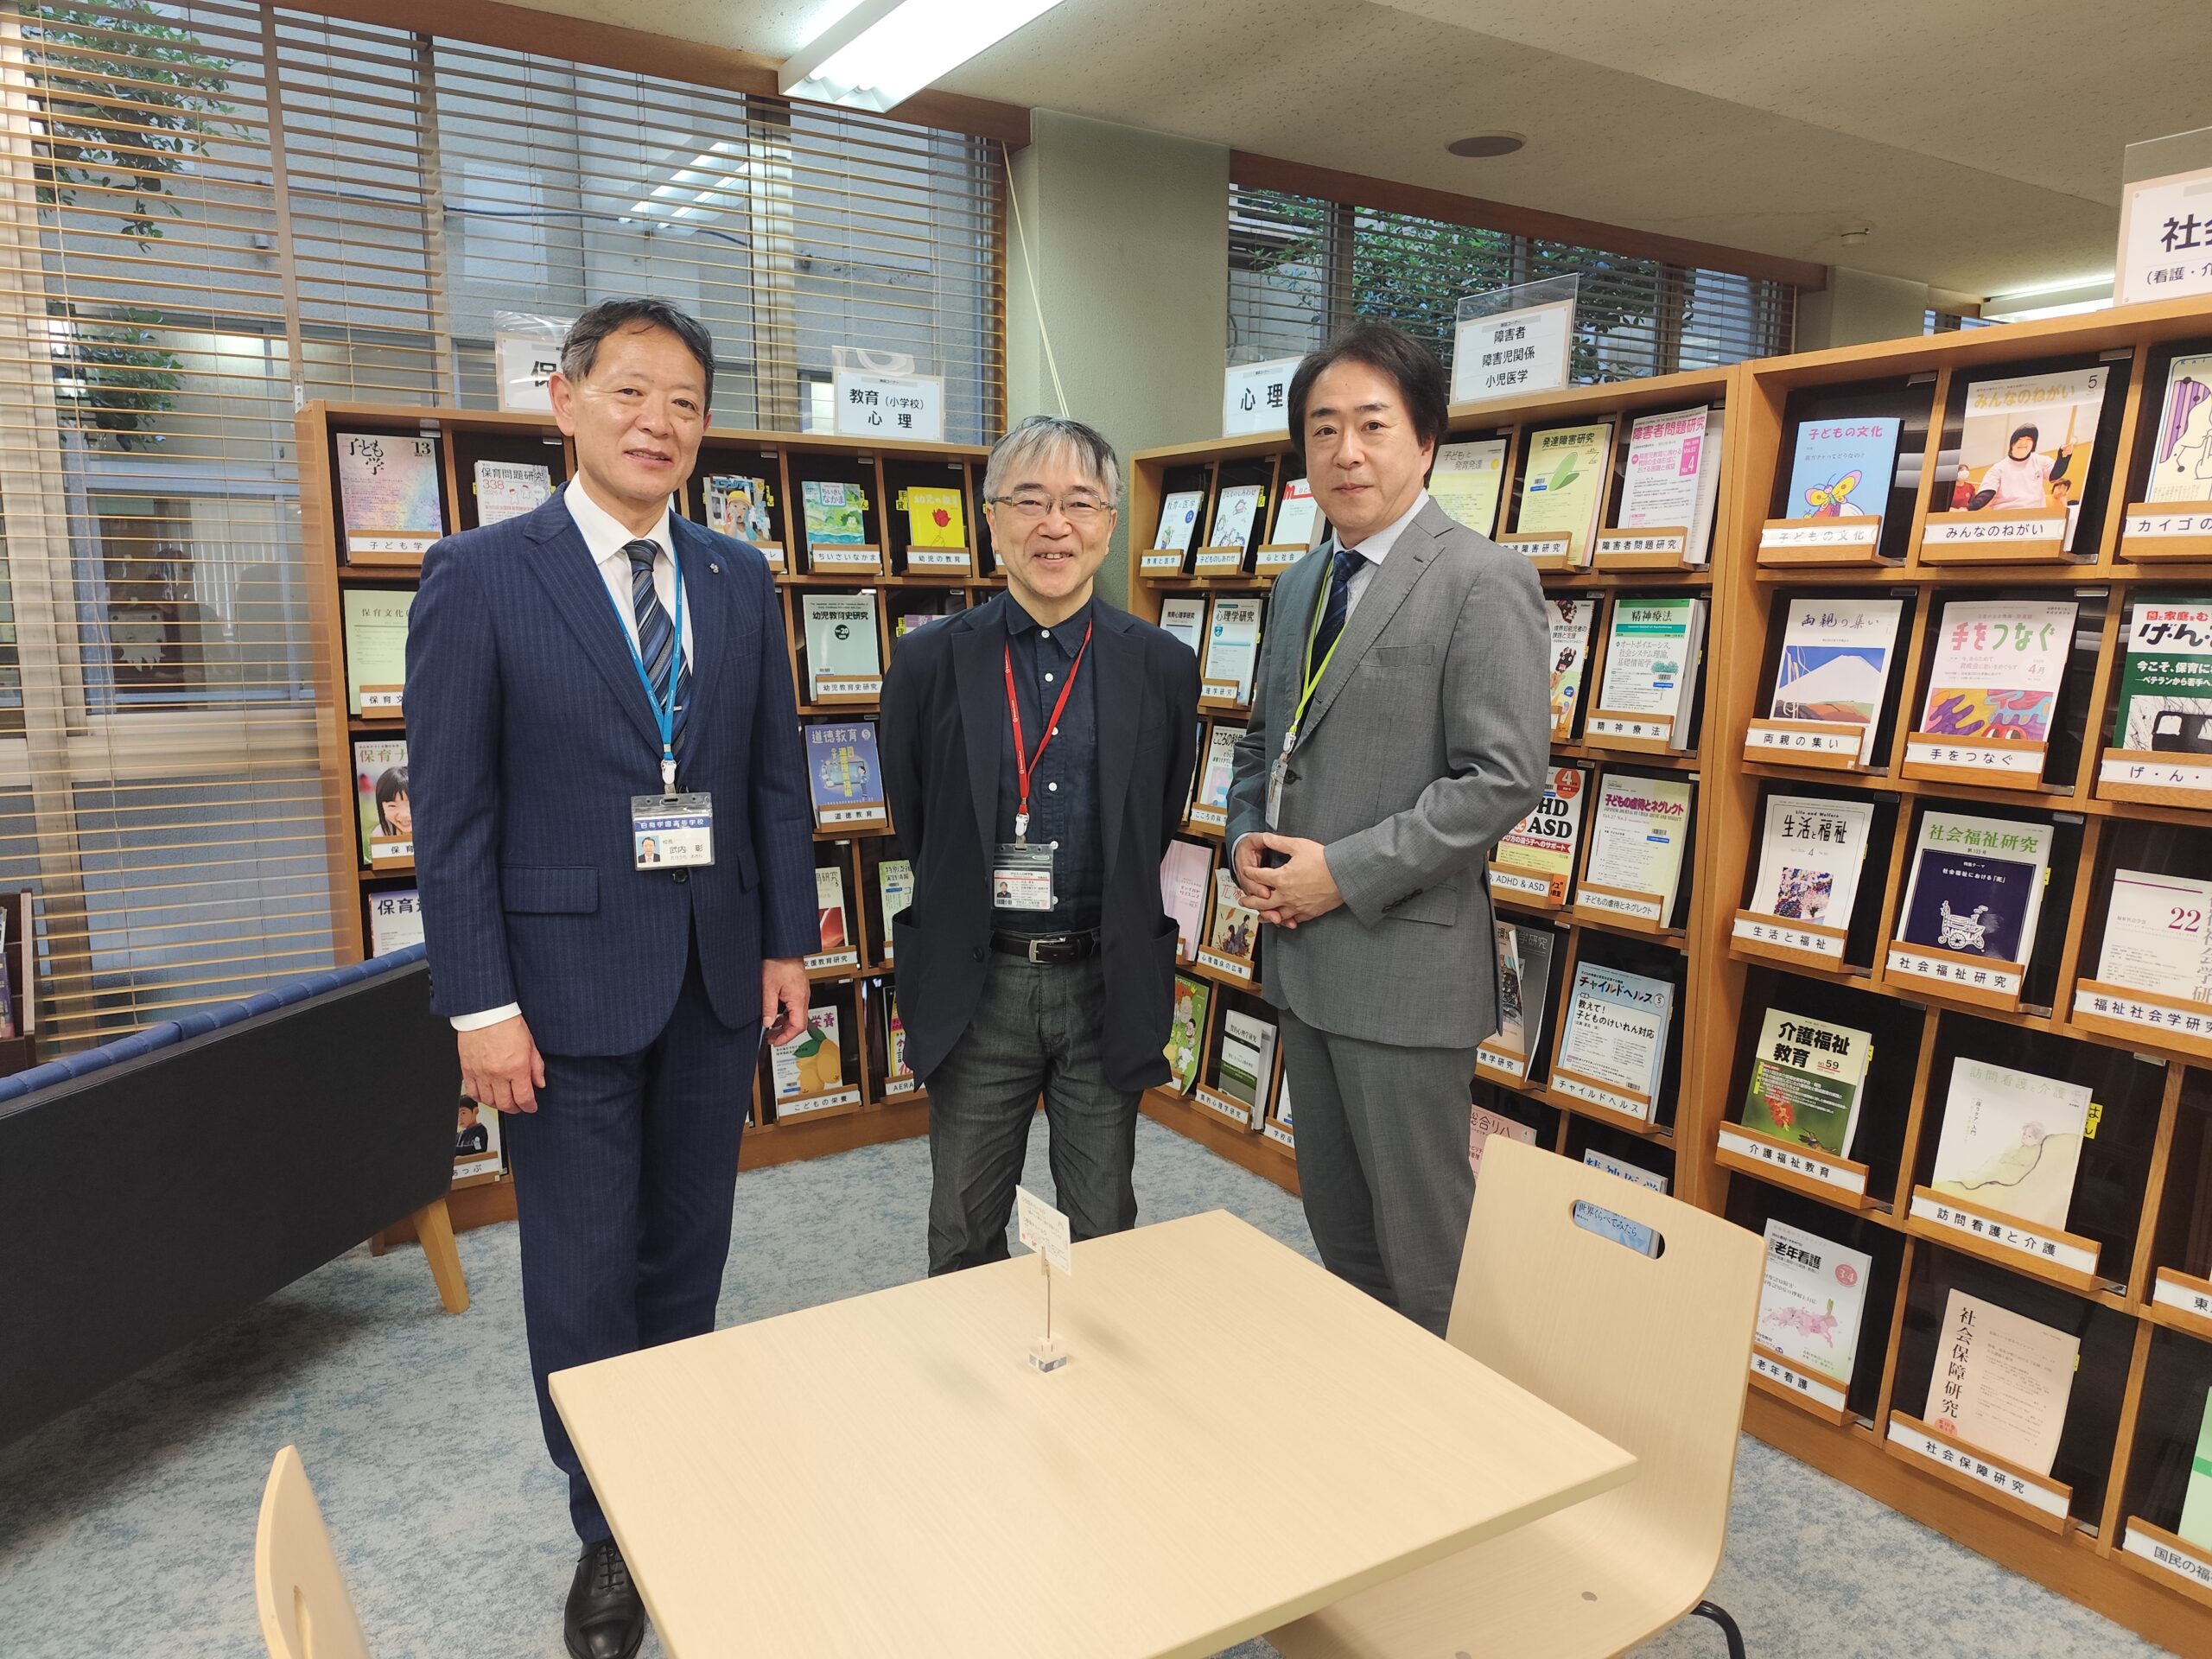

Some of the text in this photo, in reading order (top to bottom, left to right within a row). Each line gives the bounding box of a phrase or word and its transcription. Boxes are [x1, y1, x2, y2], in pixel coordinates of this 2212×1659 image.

[1493, 326, 1526, 344] 障害者
[1482, 346, 1535, 367] 障害児関係
[1485, 369, 1528, 388] 小児医学
[2088, 375, 2098, 389] 5
[1974, 385, 2075, 409] みんなのねがい
[1632, 416, 1706, 442] 障害者問題研究
[1808, 426, 1883, 441] 子どもの文化
[1542, 433, 1595, 448] 発達障害研究
[1444, 450, 1471, 461] 子どもと
[1688, 455, 1694, 471] 4
[1454, 460, 1483, 471] 発育発達
[481, 467, 544, 482] 保育問題研究
[482, 479, 505, 490] 338
[1946, 524, 2044, 538] みんなのねがい
[2138, 518, 2212, 532] カイゴの
[370, 540, 423, 550] 子ども学
[1602, 540, 1676, 550] 障害者問題研究
[1778, 530, 1865, 543] 子どもの文化
[818, 551, 876, 561] ちいさいなかま
[1267, 553, 1294, 562] 心と社会
[362, 608, 409, 617] 保育文化
[812, 611, 868, 620] 幼児教育史研究
[1216, 610, 1255, 622] 心理学研究
[1631, 610, 1673, 621] 精神療法
[2146, 611, 2212, 621] 園と家庭をむ
[1801, 613, 1879, 630] 両親の集い
[1951, 621, 2056, 652] 手をつなぐ
[2139, 623, 2212, 647] げ・ん・
[2137, 660, 2212, 674] 今こそ、保育に
[811, 728, 857, 744] 道徳教育
[1597, 721, 1661, 737] 精神療法
[1764, 734, 1839, 749] 両親の集い
[1930, 749, 2013, 766] 手をつなぐ
[1561, 770, 1573, 785] 4
[1605, 794, 1684, 816] 子どもの虐待とネグレクト
[835, 810, 872, 820] 道徳教育
[1528, 817, 1573, 838] ASD
[1782, 814, 1847, 844] 生活と福祉
[1929, 824, 2039, 854] 社会福祉研究
[1496, 875, 1519, 887] ADHD
[1528, 881, 1545, 892] ASD
[1942, 868, 2006, 884] 社会福祉における「死」
[1585, 895, 1652, 914] 子どもの虐待とネグレクト
[2168, 907, 2202, 932] 22
[1753, 925, 1827, 950] 生活と福祉
[1899, 957, 2007, 988] 社会福祉研究
[1580, 976, 1653, 1004] チャイルドヘルス
[1577, 1009, 1655, 1039] 子どものけいれん対応
[1778, 1021, 1850, 1056] 介護福祉
[1773, 1043, 1810, 1068] 教育
[1826, 1059, 1840, 1070] 59
[1970, 1066, 2066, 1100] 訪問看護と介護
[795, 1096, 847, 1110] こどもの栄養
[1559, 1080, 1638, 1113] チャイルドヘルス
[1200, 1093, 1242, 1118] 質的心理学研究
[1750, 1143, 1830, 1178] 介護福祉教育
[1937, 1207, 2056, 1257] 訪問看護と介護
[1775, 1241, 1822, 1269] 老年看護
[2194, 1296, 2212, 1313] 東
[1942, 1307, 1977, 1419] 社会保障研究
[1757, 1359, 1808, 1390] 老年看護
[1925, 1440, 2025, 1495] 社会保障研究
[2154, 1546, 2212, 1582] 国民の福
